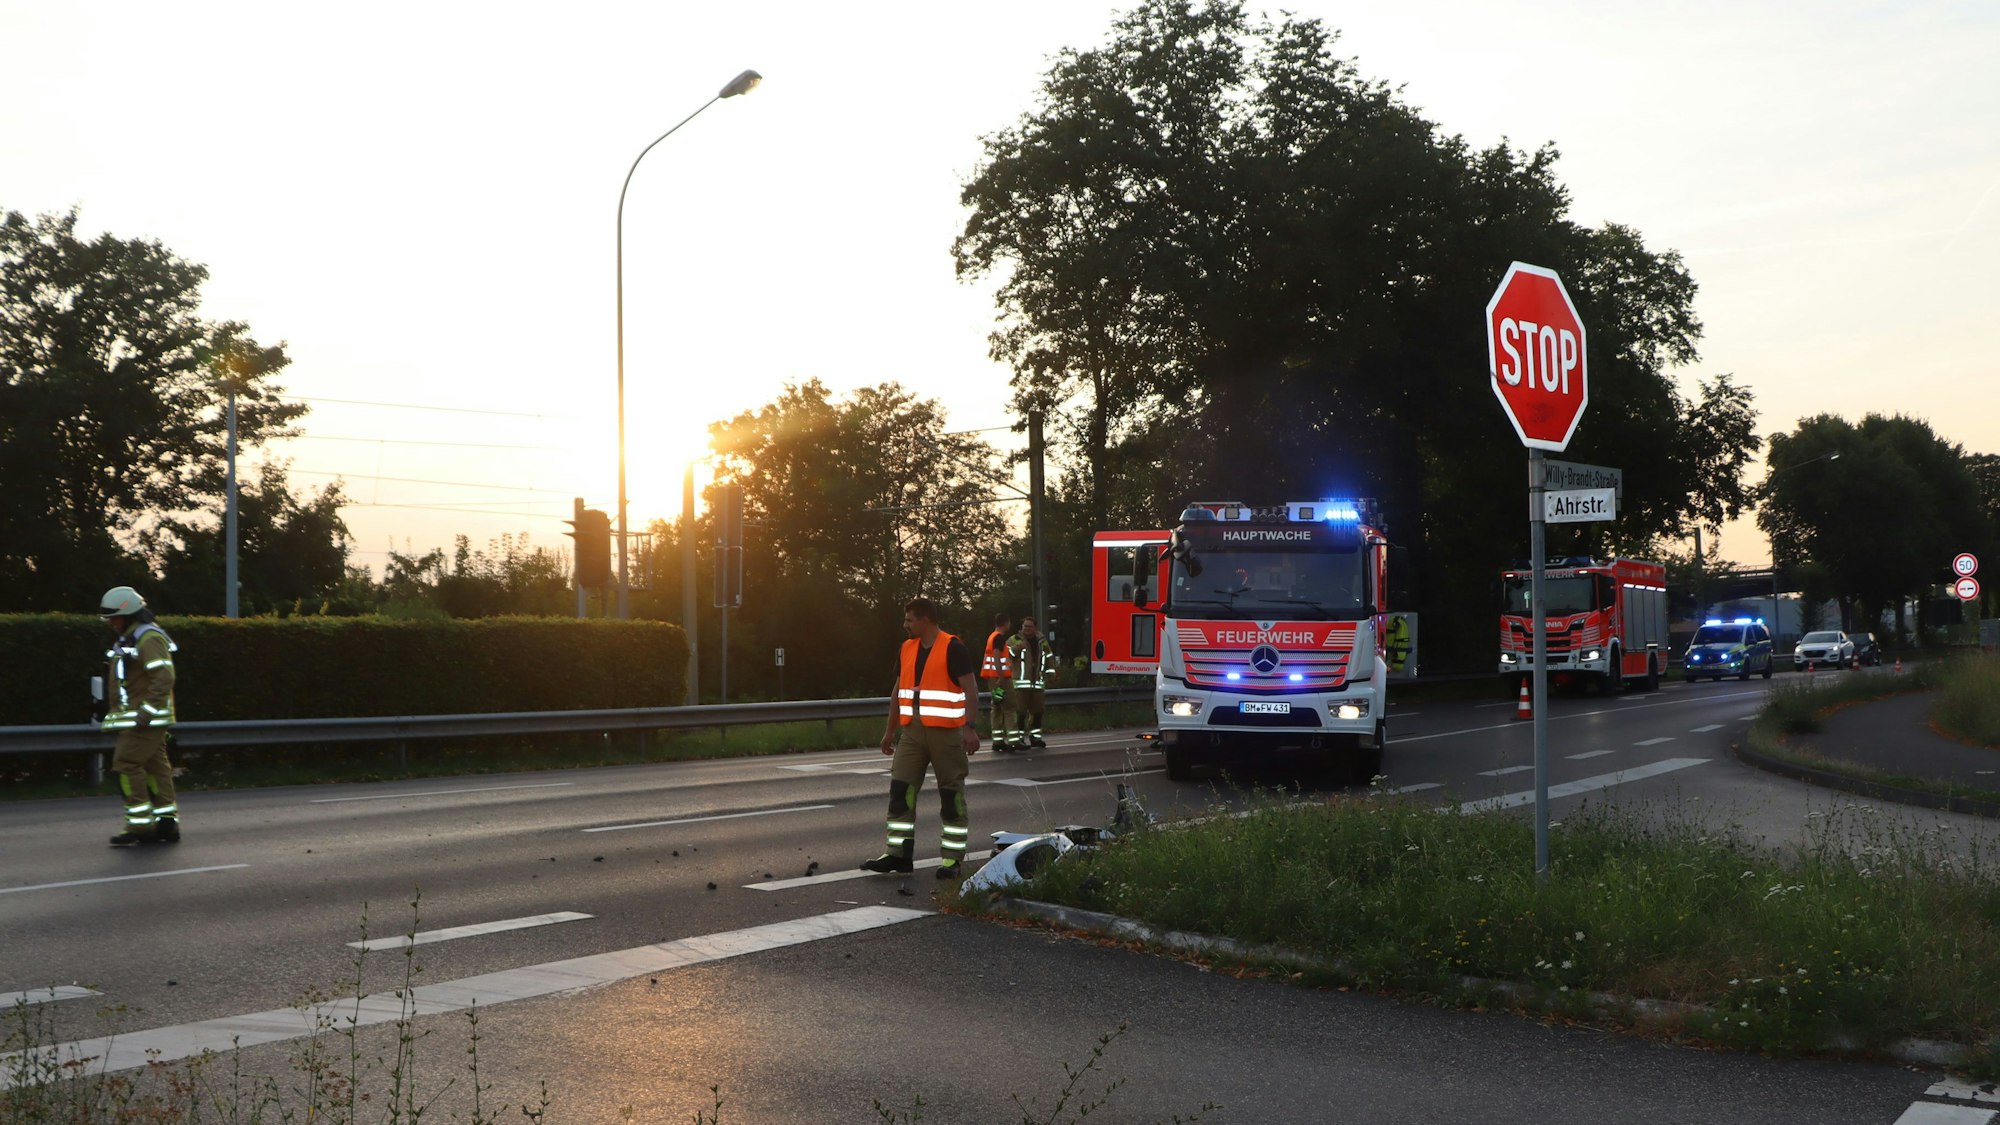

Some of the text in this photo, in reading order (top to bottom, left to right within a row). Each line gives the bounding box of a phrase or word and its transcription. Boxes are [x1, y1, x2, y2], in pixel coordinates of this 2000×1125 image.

[1500, 317, 1577, 394] STOP
[1555, 496, 1607, 515] Ahrstr.
[1223, 531, 1312, 541] HAUPTWACHE
[1959, 560, 1973, 571] 50
[1216, 630, 1315, 644] FEUERWEHR
[776, 649, 784, 665] H
[1107, 663, 1151, 673] Schlingmann
[1273, 704, 1289, 713] 431
